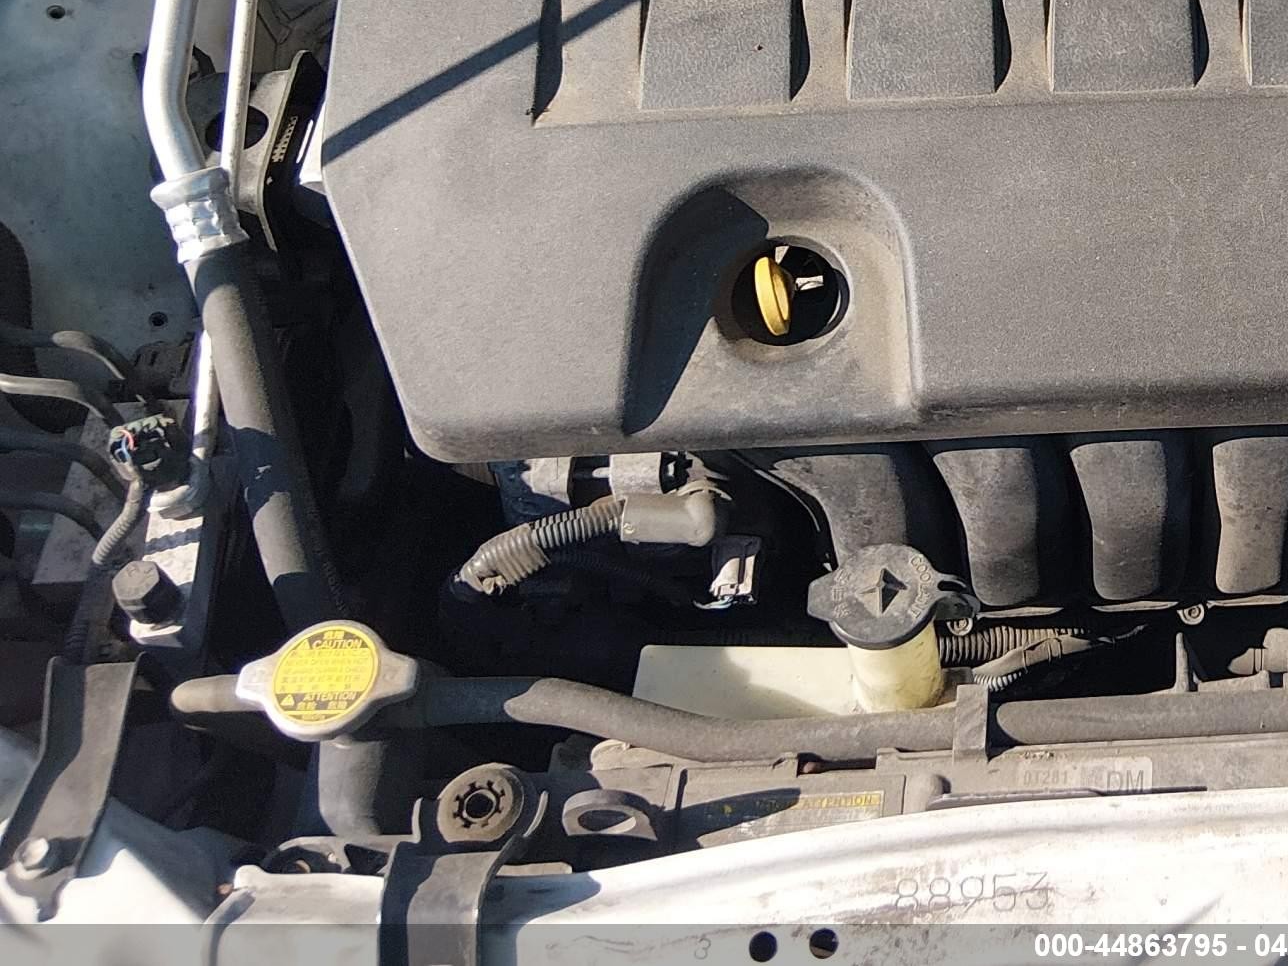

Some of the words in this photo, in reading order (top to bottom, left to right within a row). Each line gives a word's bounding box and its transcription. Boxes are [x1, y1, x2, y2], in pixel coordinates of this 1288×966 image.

[312, 639, 362, 650] CAUTION
[303, 692, 357, 701] ATTENTION
[1106, 769, 1145, 792] DM
[895, 871, 1052, 914] 88953
